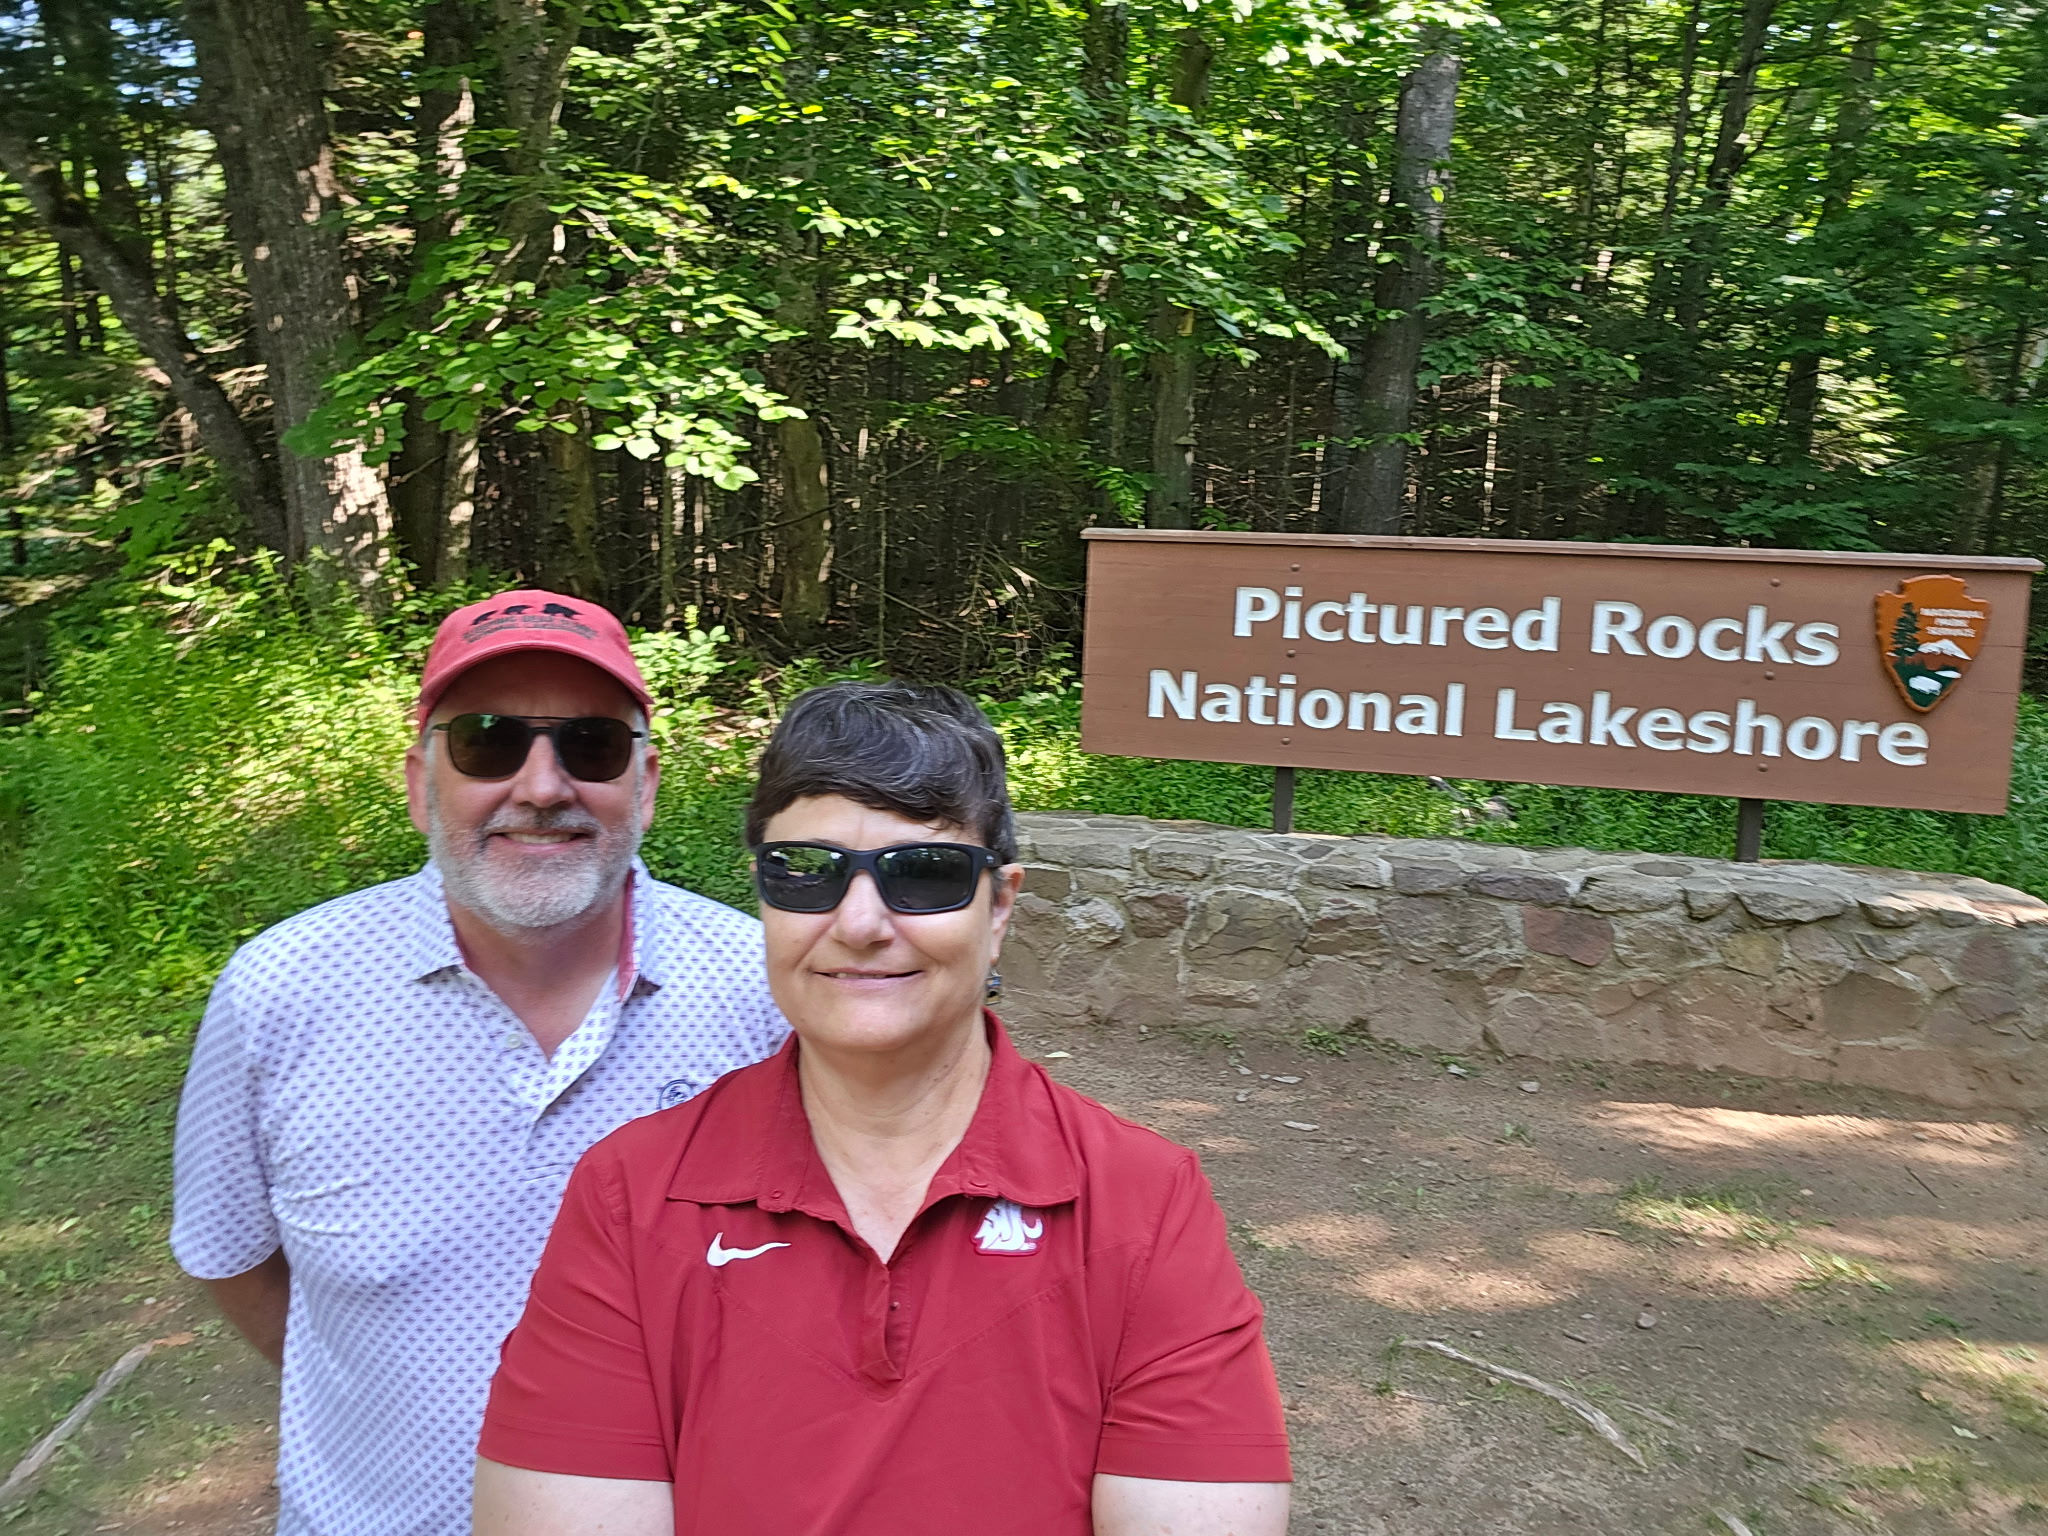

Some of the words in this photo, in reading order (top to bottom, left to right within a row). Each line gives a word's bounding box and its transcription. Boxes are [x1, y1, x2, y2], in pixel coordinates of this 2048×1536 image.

[1234, 586, 1562, 654] Pictured
[1591, 600, 1840, 667] Rocks
[1147, 669, 1465, 739] National
[1494, 689, 1929, 767] Lakeshore
